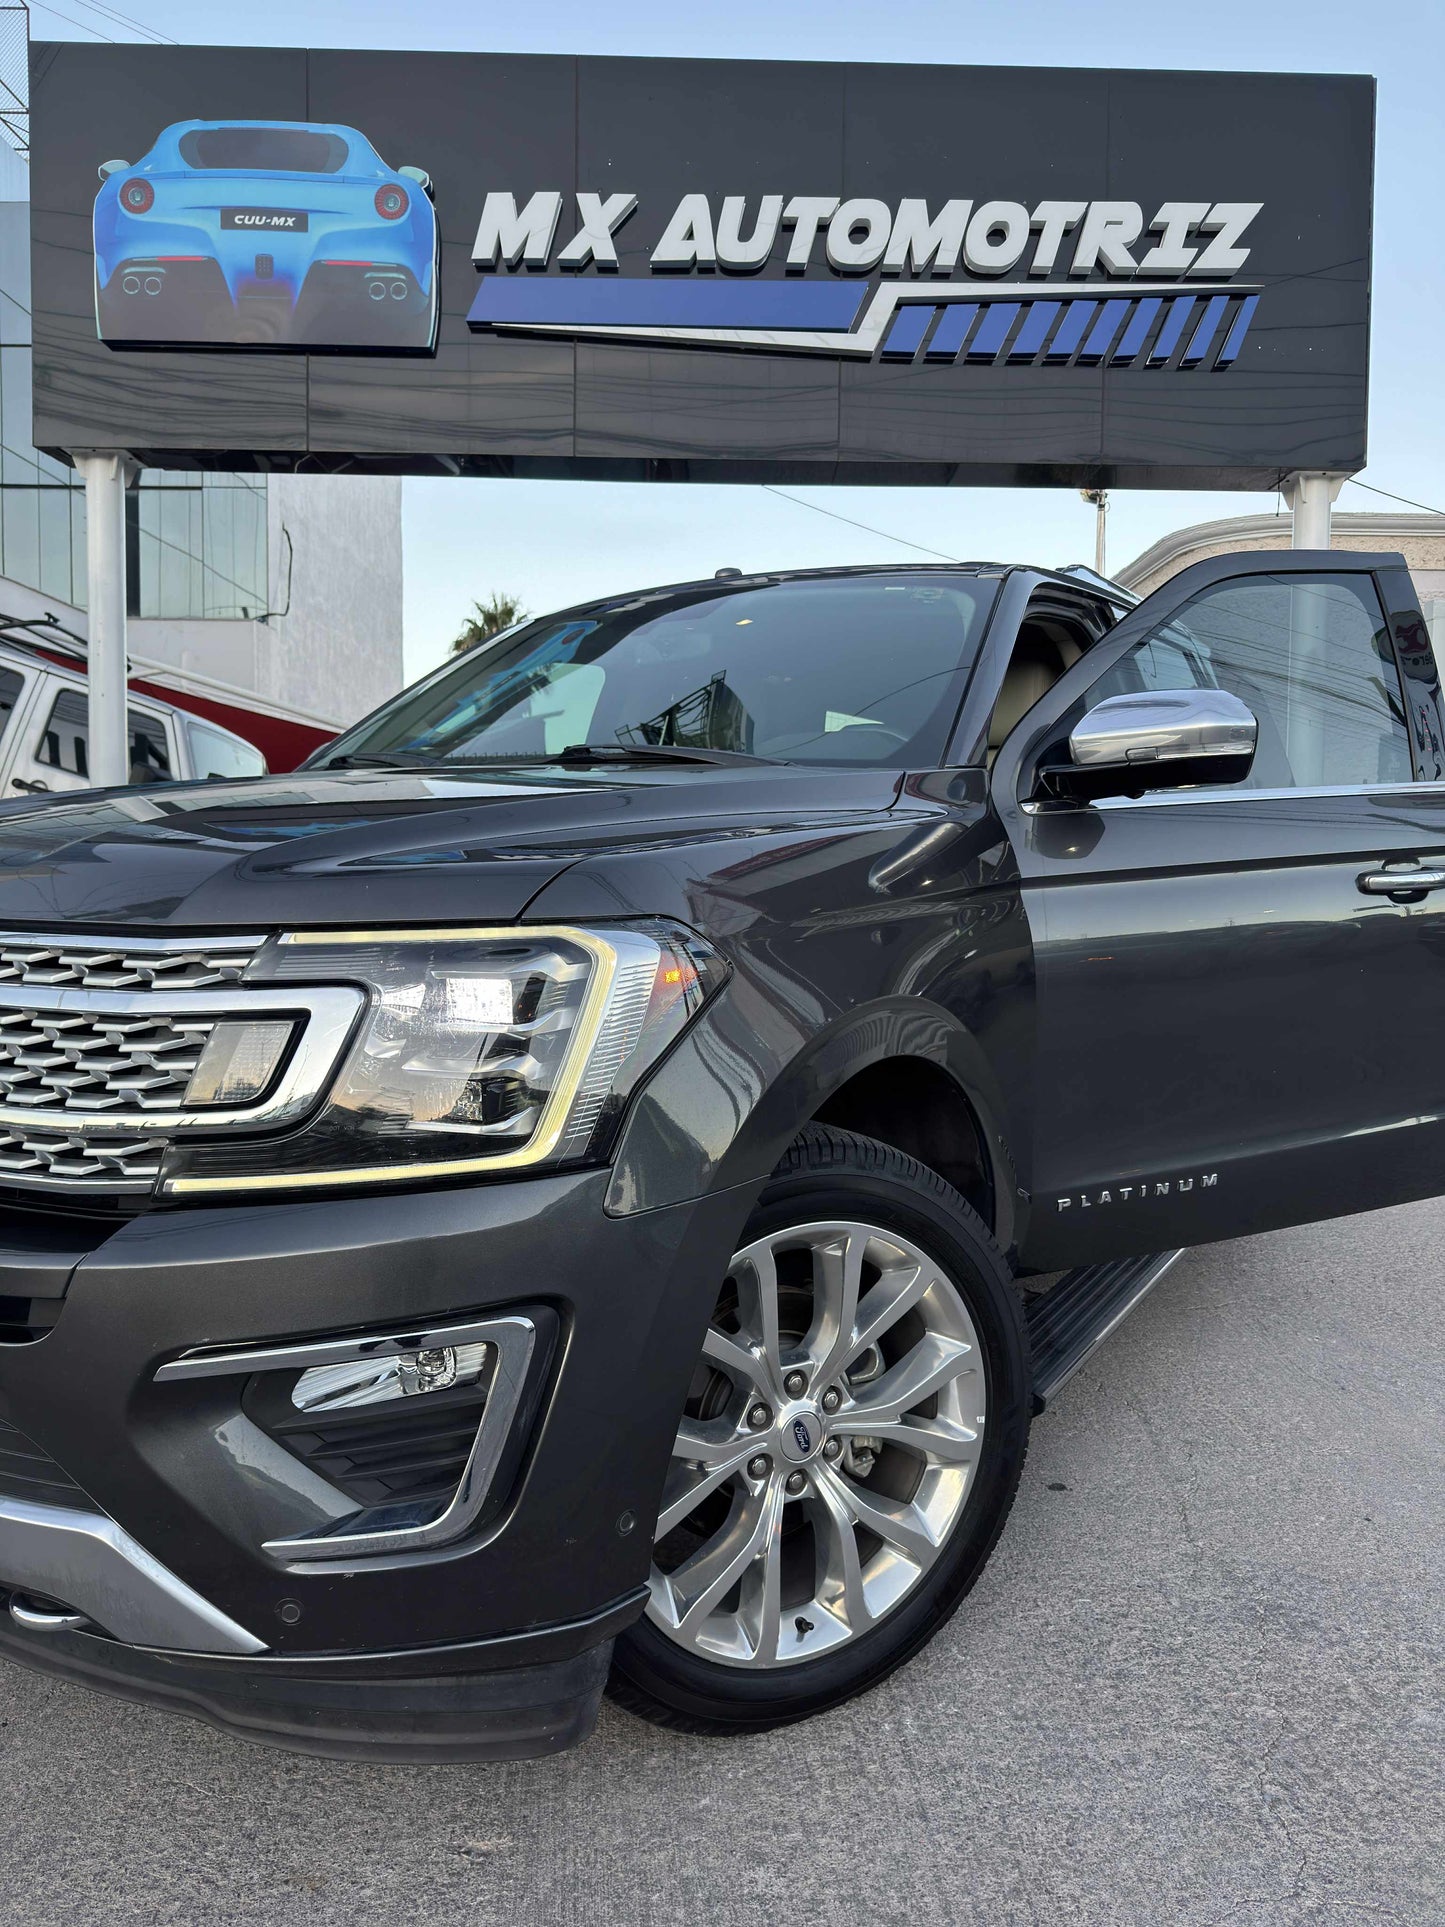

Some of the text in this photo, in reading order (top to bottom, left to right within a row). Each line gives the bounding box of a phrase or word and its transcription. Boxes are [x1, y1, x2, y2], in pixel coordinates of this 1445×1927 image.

[234, 215, 297, 227] CUU-MX
[471, 191, 1264, 277] MX AUTOMOTRIZ
[1057, 1173, 1219, 1212] PLATINUM
[794, 1424, 809, 1450] Ford
